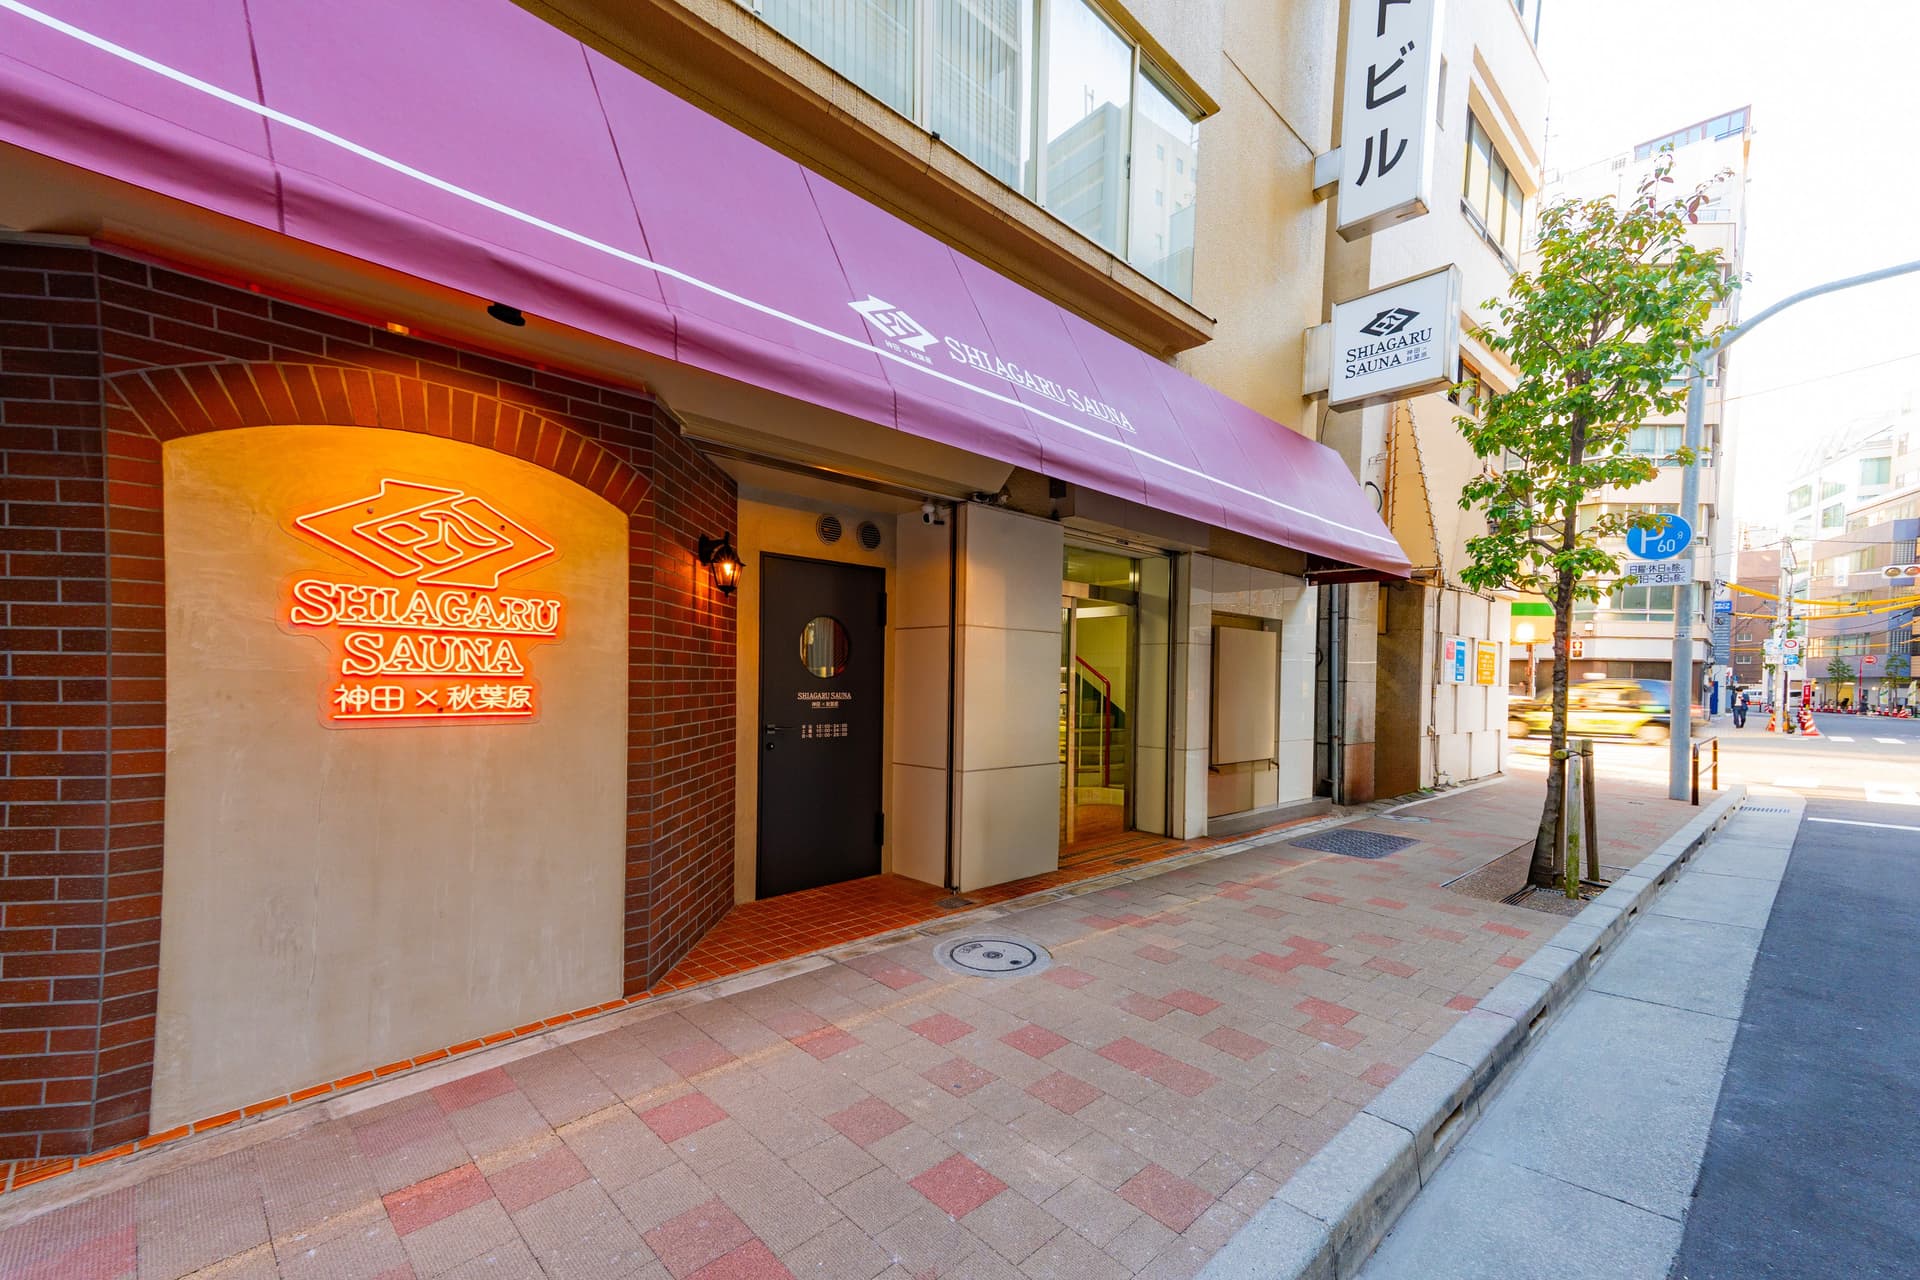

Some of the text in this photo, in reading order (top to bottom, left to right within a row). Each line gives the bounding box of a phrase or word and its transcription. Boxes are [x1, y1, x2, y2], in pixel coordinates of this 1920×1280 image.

[1346, 328, 1432, 363] SHIAGARU
[944, 336, 1066, 403] SHIAGARU
[1067, 388, 1135, 431] SAUNA
[1345, 354, 1402, 379] SAUNA
[1657, 539, 1676, 553] 60
[290, 579, 560, 632] SHIAGARU
[342, 631, 524, 676] SAUNA
[334, 683, 404, 712] 神田
[447, 683, 533, 710] 秋葉原
